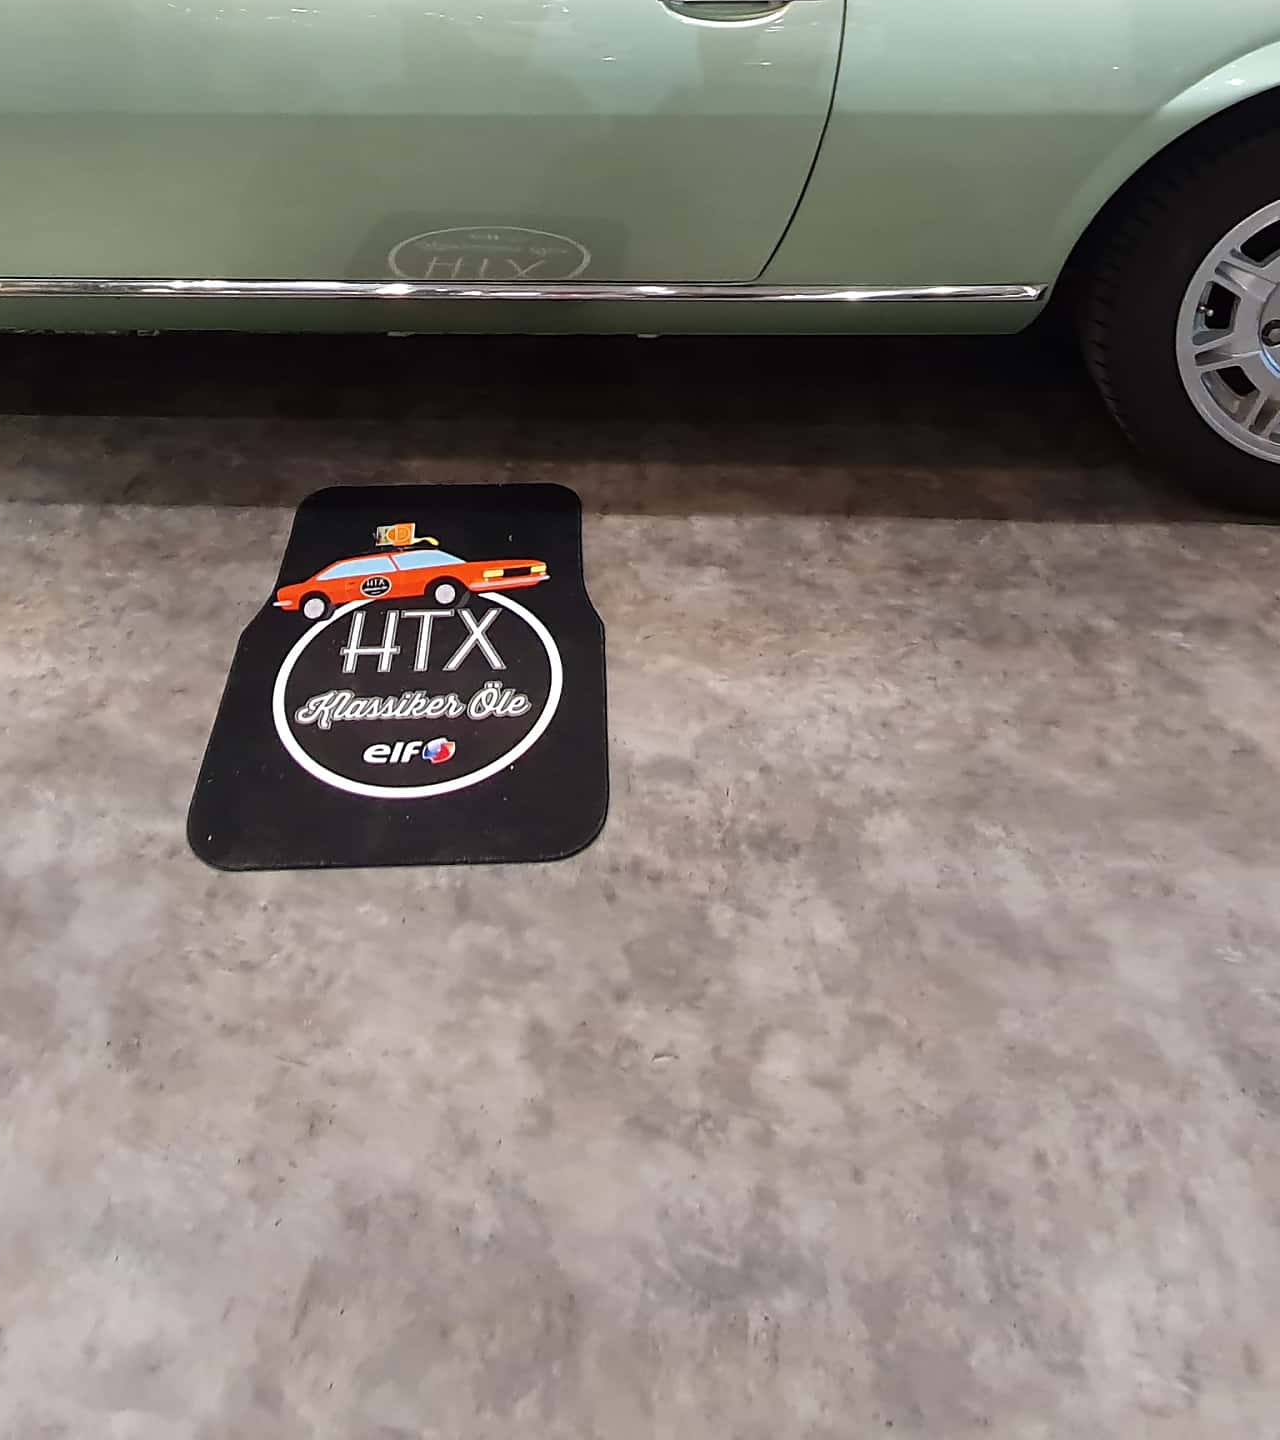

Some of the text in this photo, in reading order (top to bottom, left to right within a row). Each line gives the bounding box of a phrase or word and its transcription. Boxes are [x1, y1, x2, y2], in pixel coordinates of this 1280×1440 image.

[340, 608, 507, 673] HTX
[295, 681, 532, 730] Klassiker Öle
[363, 741, 423, 764] elf
